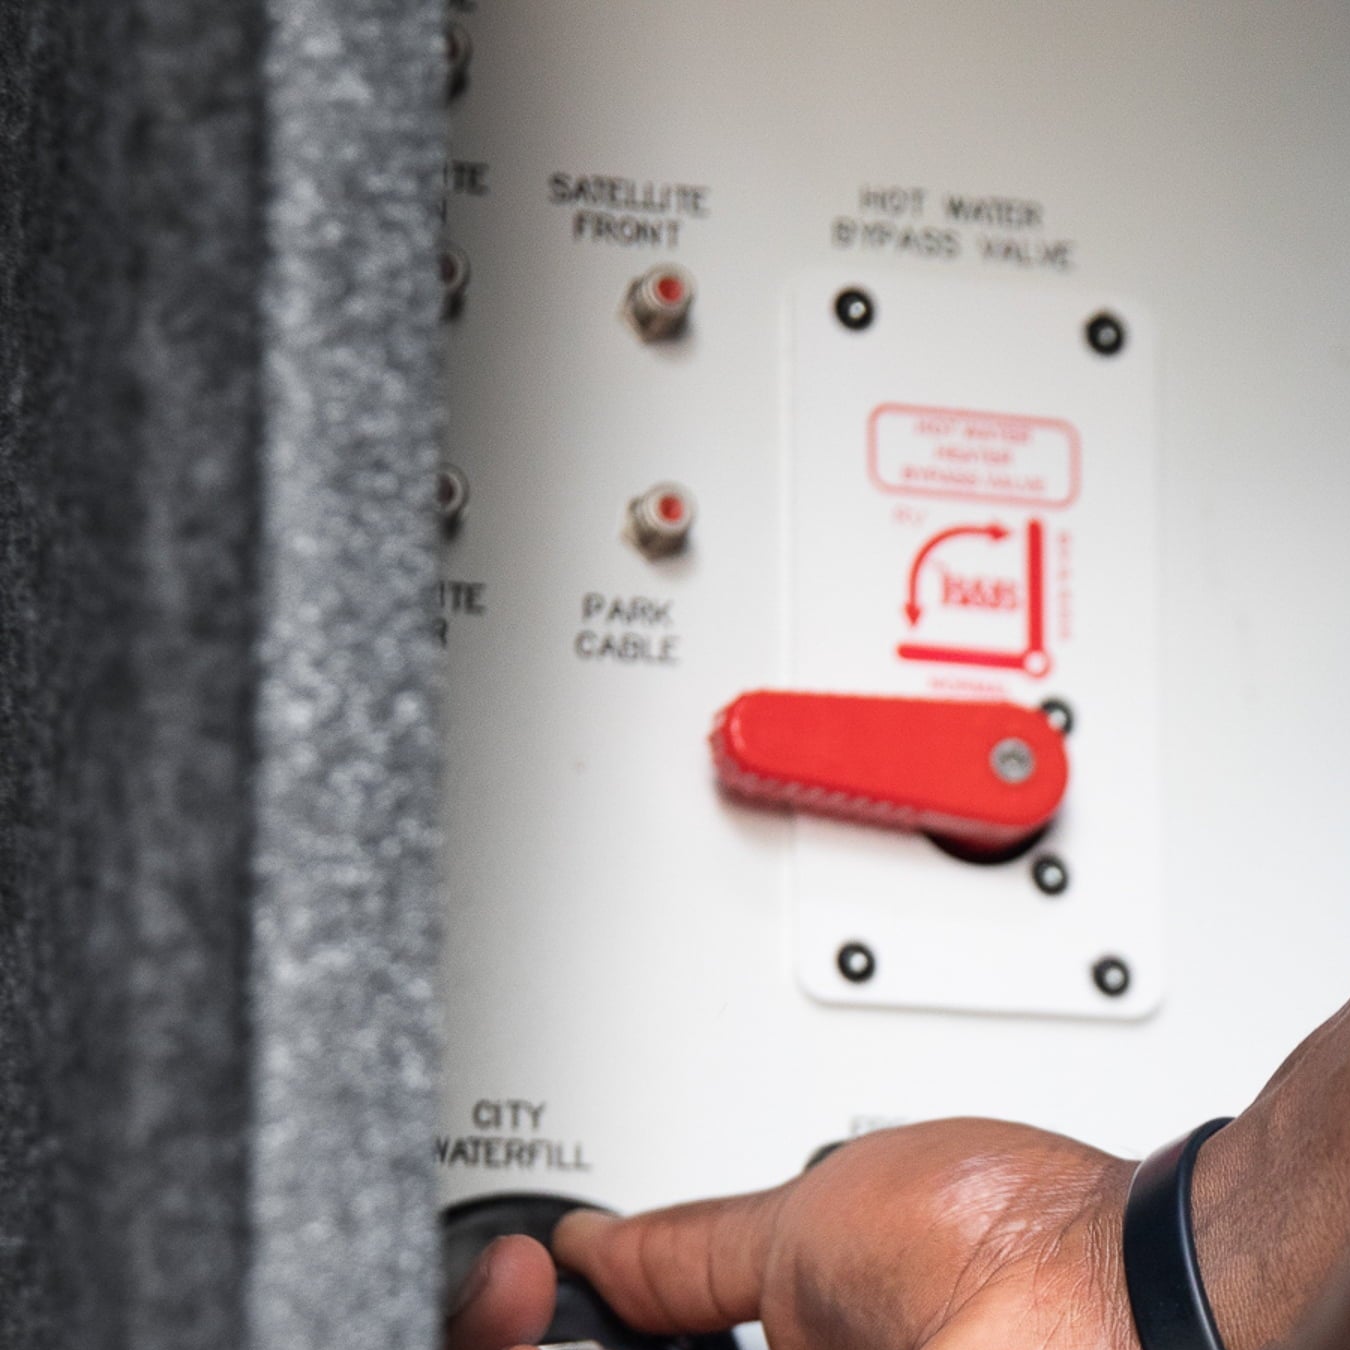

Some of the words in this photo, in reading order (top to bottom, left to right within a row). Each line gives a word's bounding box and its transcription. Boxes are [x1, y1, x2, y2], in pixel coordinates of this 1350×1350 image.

[549, 172, 710, 219] SATELLITE
[858, 184, 924, 216] HOT
[943, 195, 1044, 229] WATER
[572, 209, 682, 247] FRONT
[831, 216, 960, 260] BYPASS
[975, 236, 1077, 273] VALVE
[582, 592, 674, 626] PARK
[574, 629, 681, 666] CABLE
[473, 1099, 546, 1130] CITY
